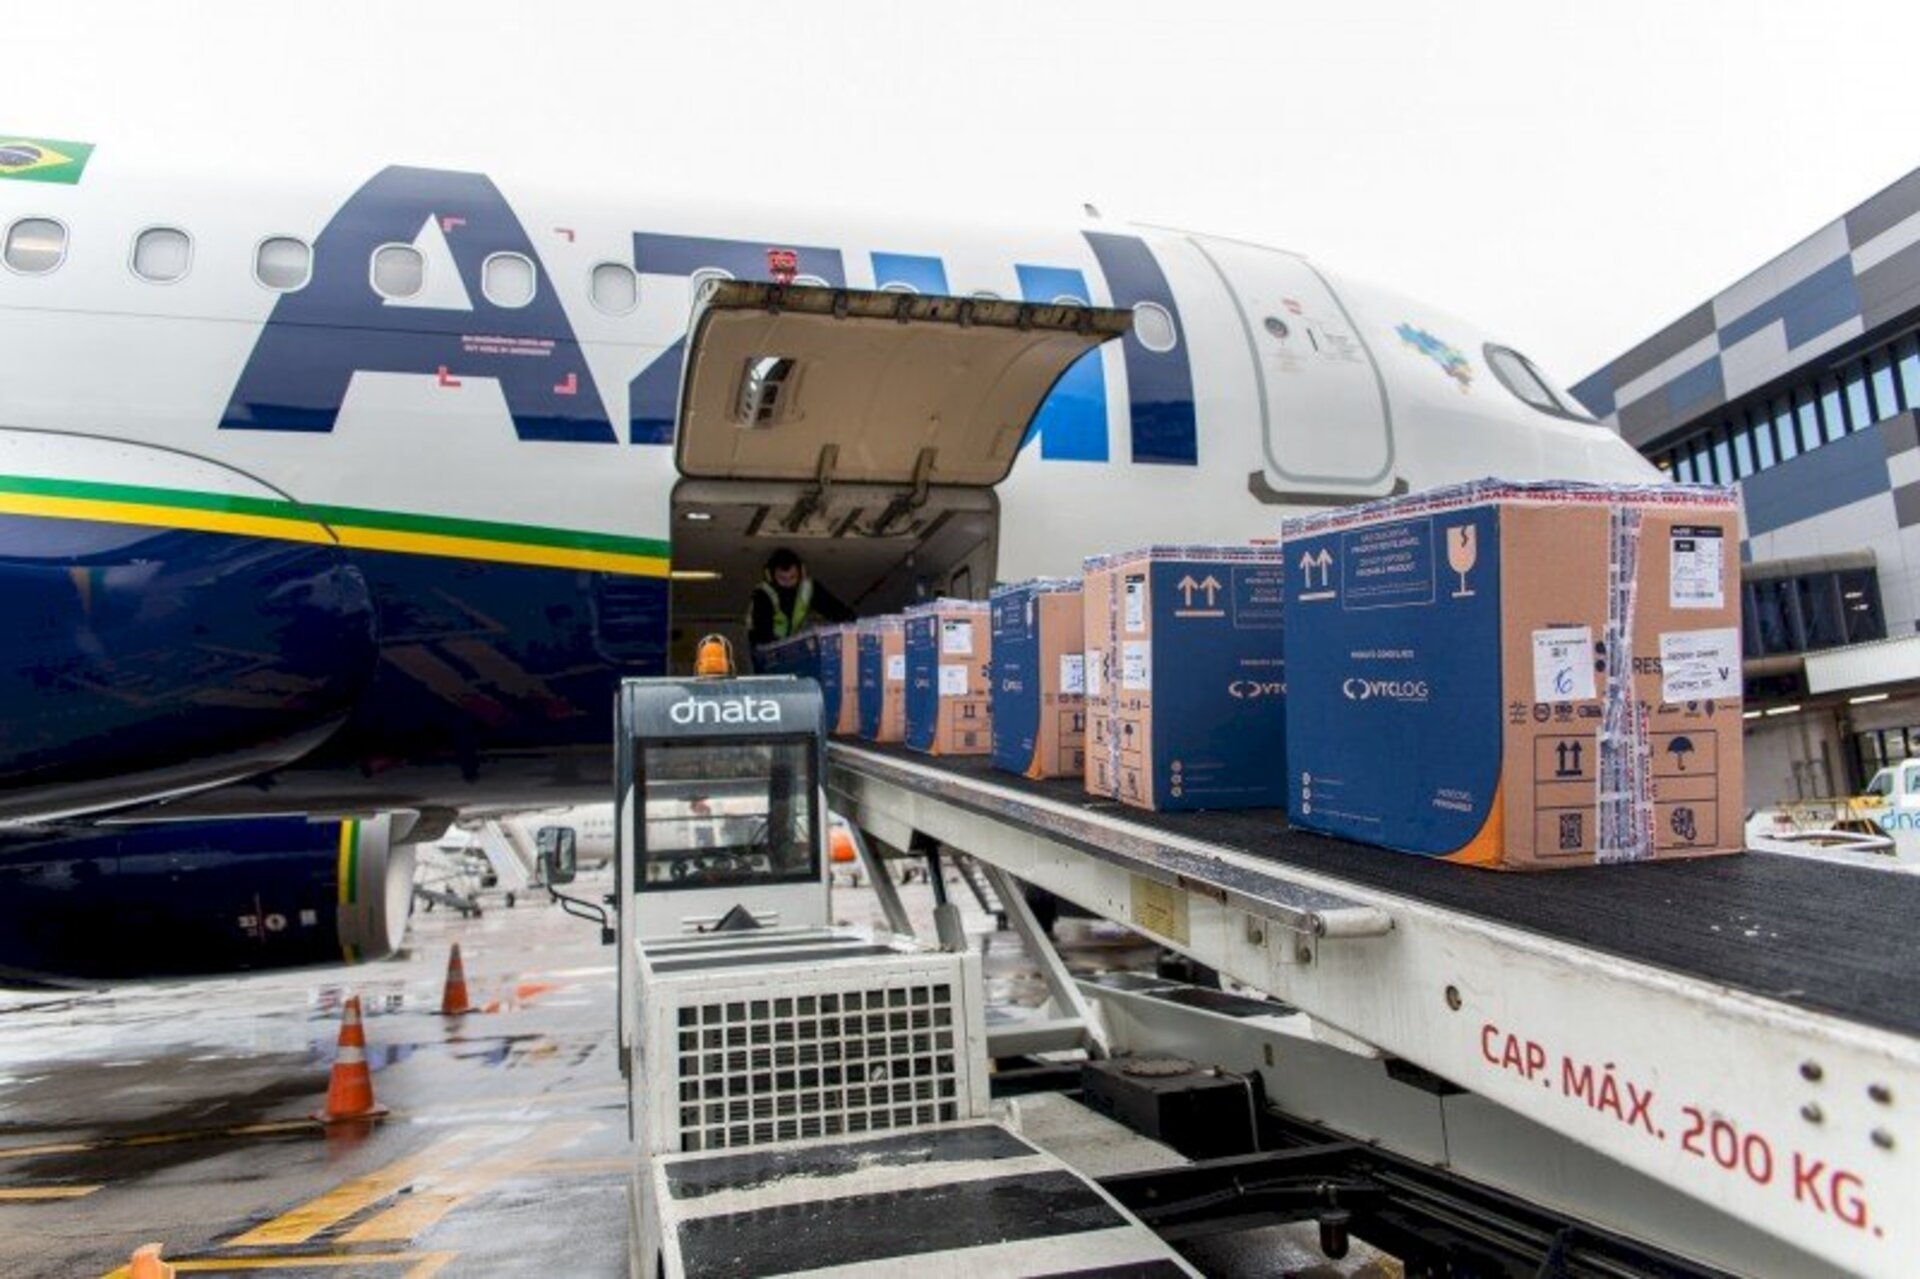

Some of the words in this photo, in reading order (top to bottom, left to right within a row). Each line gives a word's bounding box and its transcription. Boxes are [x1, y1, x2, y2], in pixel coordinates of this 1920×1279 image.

[670, 696, 782, 724] dnata
[1880, 808, 1920, 831] dn
[1481, 1024, 1551, 1088] CAP.
[1562, 1056, 1666, 1140] MÁX.
[1681, 1106, 1774, 1186] 200
[1793, 1152, 1886, 1239] KG.
